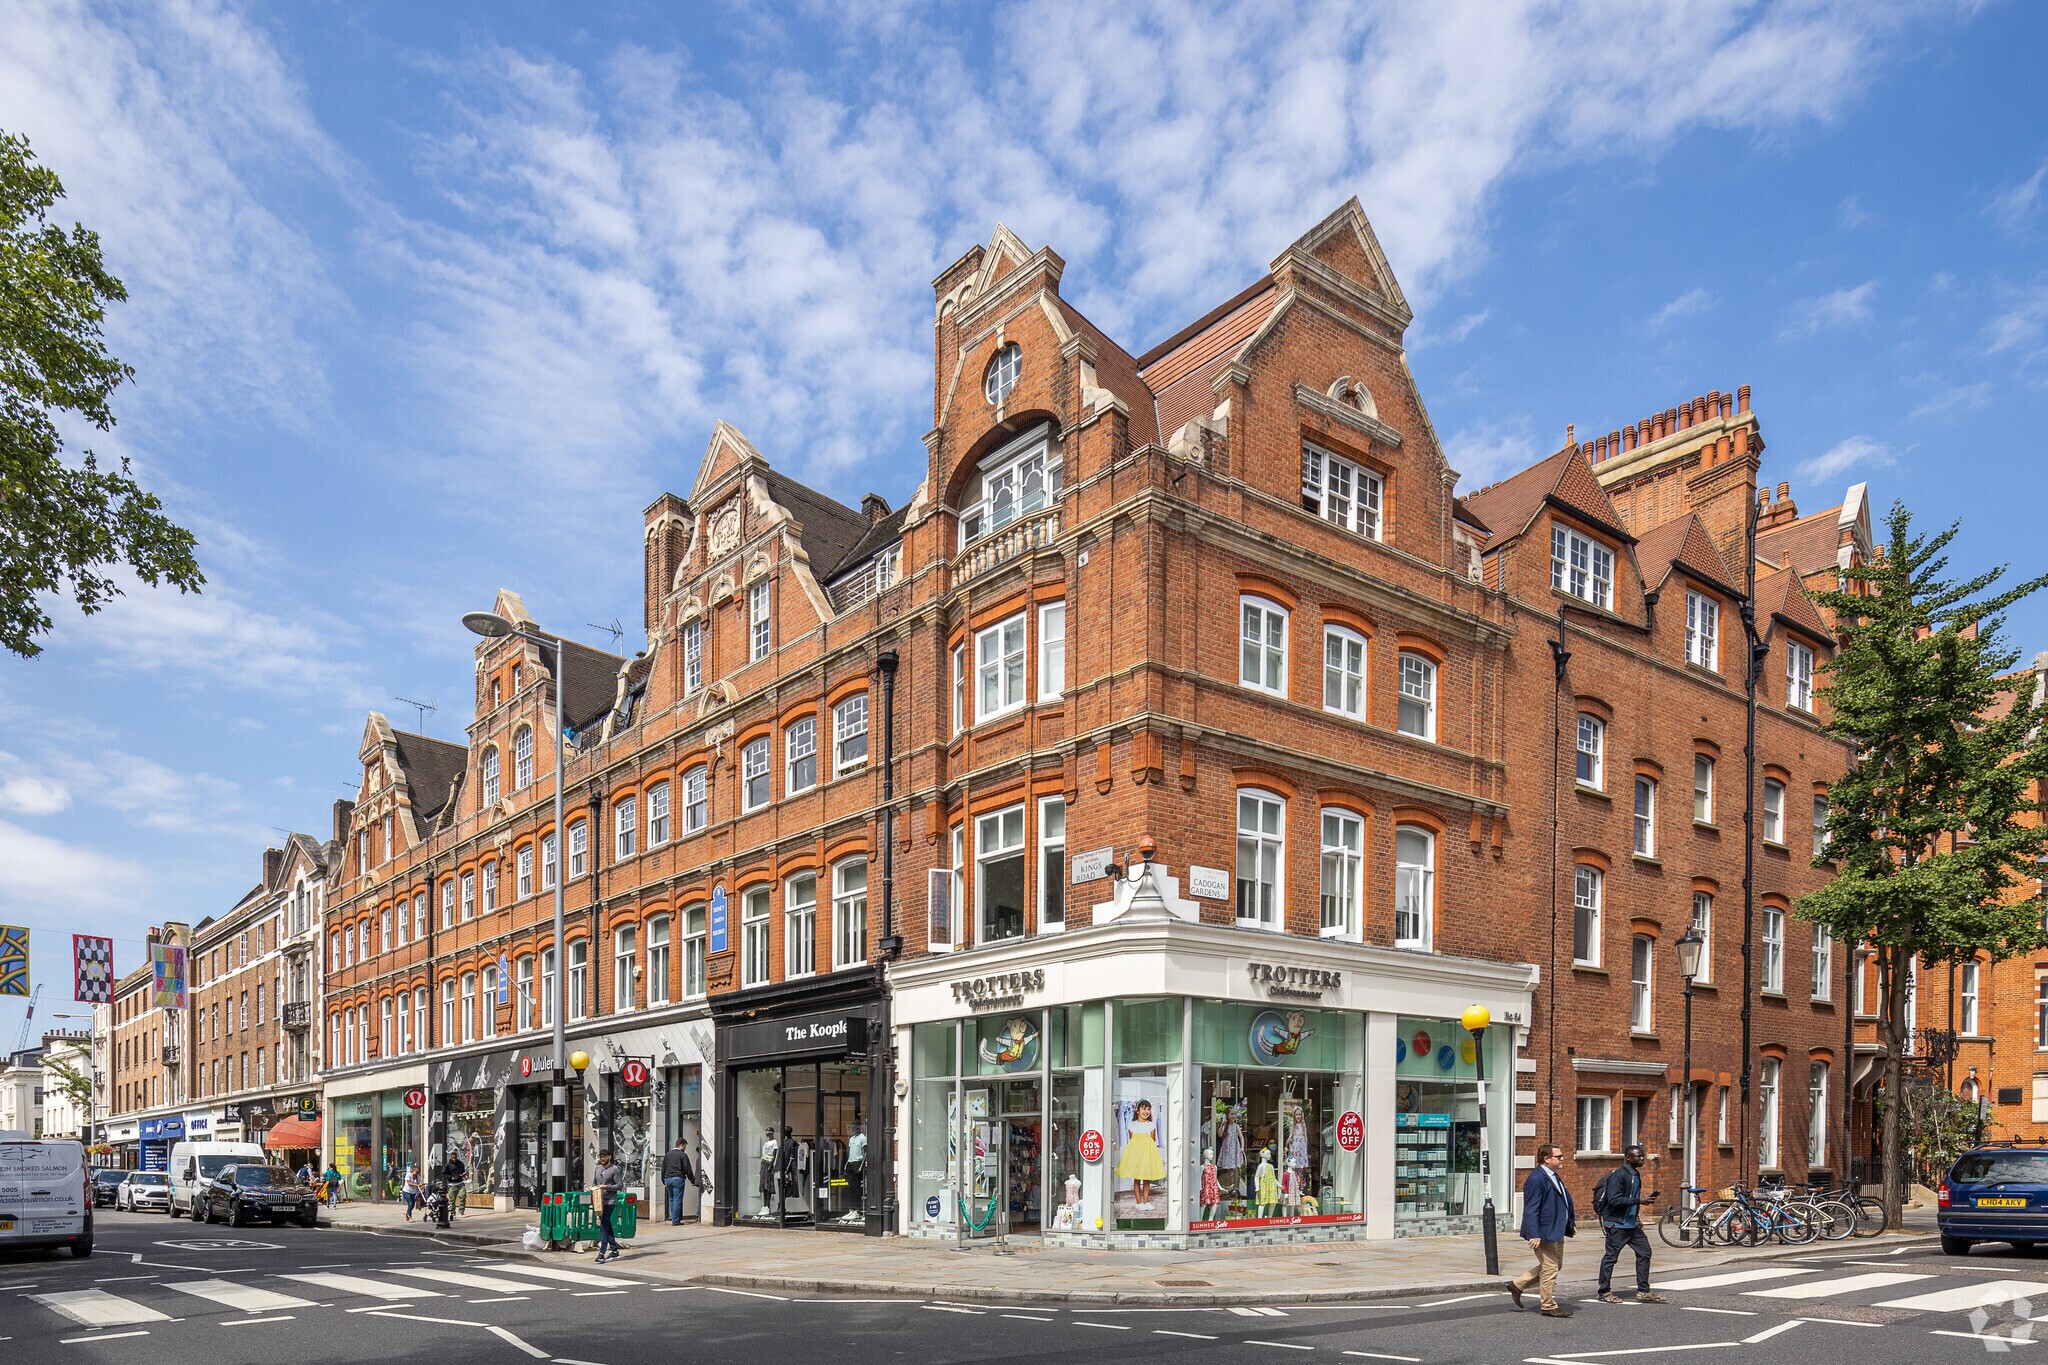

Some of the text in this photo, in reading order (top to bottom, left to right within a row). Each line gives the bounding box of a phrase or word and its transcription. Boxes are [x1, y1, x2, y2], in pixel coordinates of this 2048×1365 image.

[1080, 862, 1102, 873] KINGS
[1076, 872, 1096, 882] ROAD
[1193, 878, 1226, 890] CADOGAN
[1190, 886, 1221, 898] GARDENS
[1247, 962, 1341, 988] TROTTERS
[950, 968, 1044, 997] TROTTERS
[785, 1019, 848, 1041] The Koople
[304, 1099, 310, 1109] F
[356, 1101, 372, 1115] Foxton
[191, 1118, 208, 1131] OFFICE
[1343, 1115, 1358, 1126] Sale
[1341, 1126, 1360, 1136] 60%
[1085, 1133, 1098, 1142] Sale
[1341, 1136, 1360, 1145] OFF
[1083, 1141, 1100, 1149] 60%
[1214, 1220, 1229, 1229] Sale
[1289, 1216, 1302, 1225] Sale
